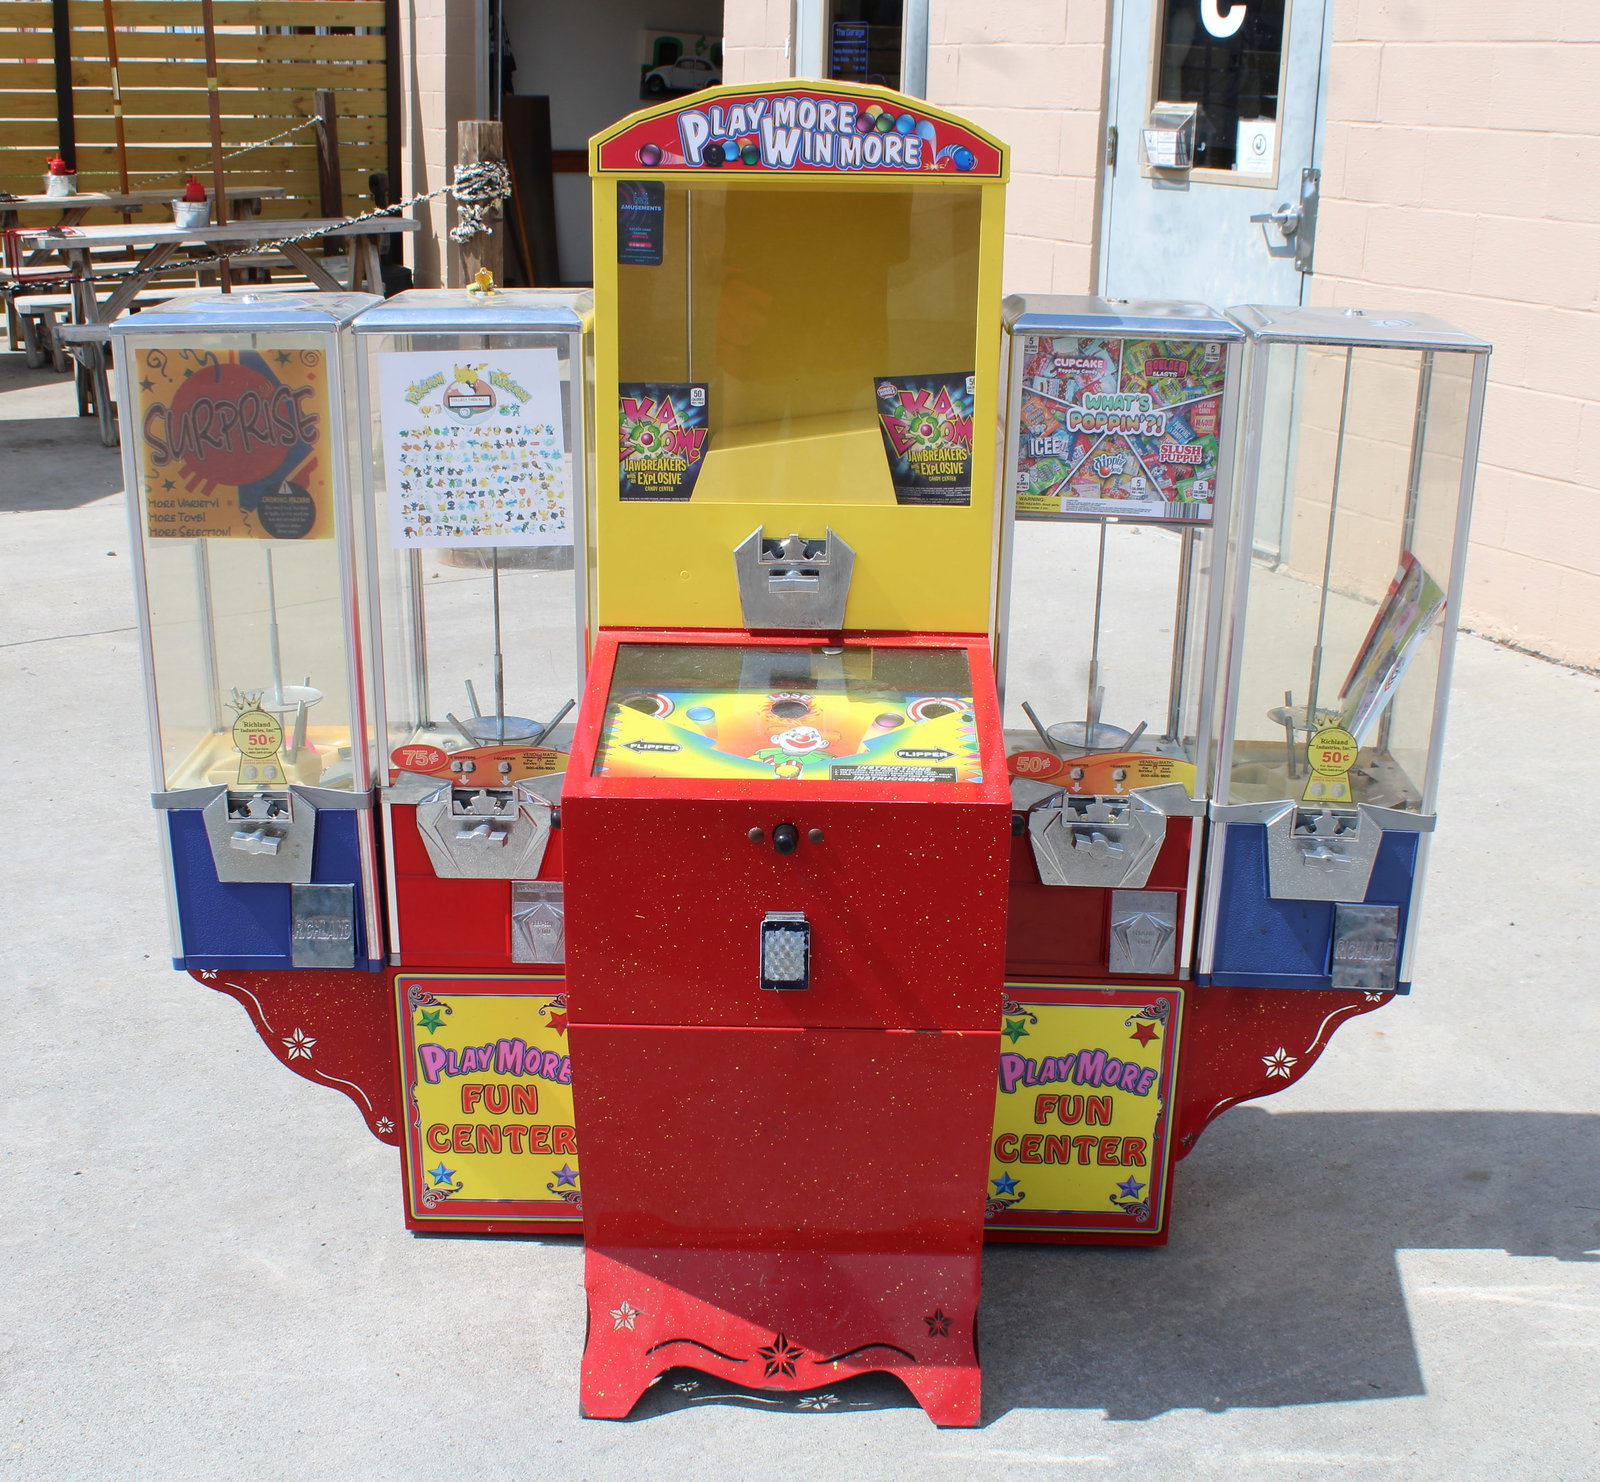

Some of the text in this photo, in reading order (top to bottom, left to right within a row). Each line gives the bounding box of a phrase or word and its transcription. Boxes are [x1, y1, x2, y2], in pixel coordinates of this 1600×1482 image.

[678, 97, 857, 167] PLAY MORE
[761, 114, 922, 169] WIN MORE
[1210, 345, 1216, 353] 5
[1053, 358, 1104, 369] CUPCAKE
[1145, 359, 1186, 376] BOULDER
[693, 390, 702, 398] 50
[1085, 394, 1151, 412] WHAT'S
[144, 384, 320, 466] SURPRISE
[1069, 410, 1164, 434] POPPIN'?!
[1029, 437, 1061, 456] ICEE
[1160, 444, 1202, 455] SLUSH
[907, 449, 968, 462] JAWBREAKERS
[624, 458, 687, 472] JAWBREAKERS
[921, 463, 964, 475] EXPLOSIVE
[637, 472, 682, 485] EXPLOSIVE
[1136, 479, 1141, 487] 5
[149, 498, 219, 509] MORE VARIETY!
[149, 511, 206, 523] MORE TOYS!
[149, 526, 231, 537] MORE SELECTION!
[769, 691, 812, 702] LOSE
[248, 734, 276, 746] 50¢
[630, 743, 680, 751] FLIPPER
[402, 750, 439, 766] 75¢
[1016, 757, 1051, 772] 50¢
[1322, 752, 1351, 763] 50¢
[293, 919, 352, 940] RICHLAND
[1336, 938, 1395, 960] RICHLAND
[461, 1084, 539, 1115] FUN
[1034, 1094, 1114, 1126] FUN
[426, 1123, 578, 1154] CENTER
[994, 1133, 1147, 1167] CENTER
